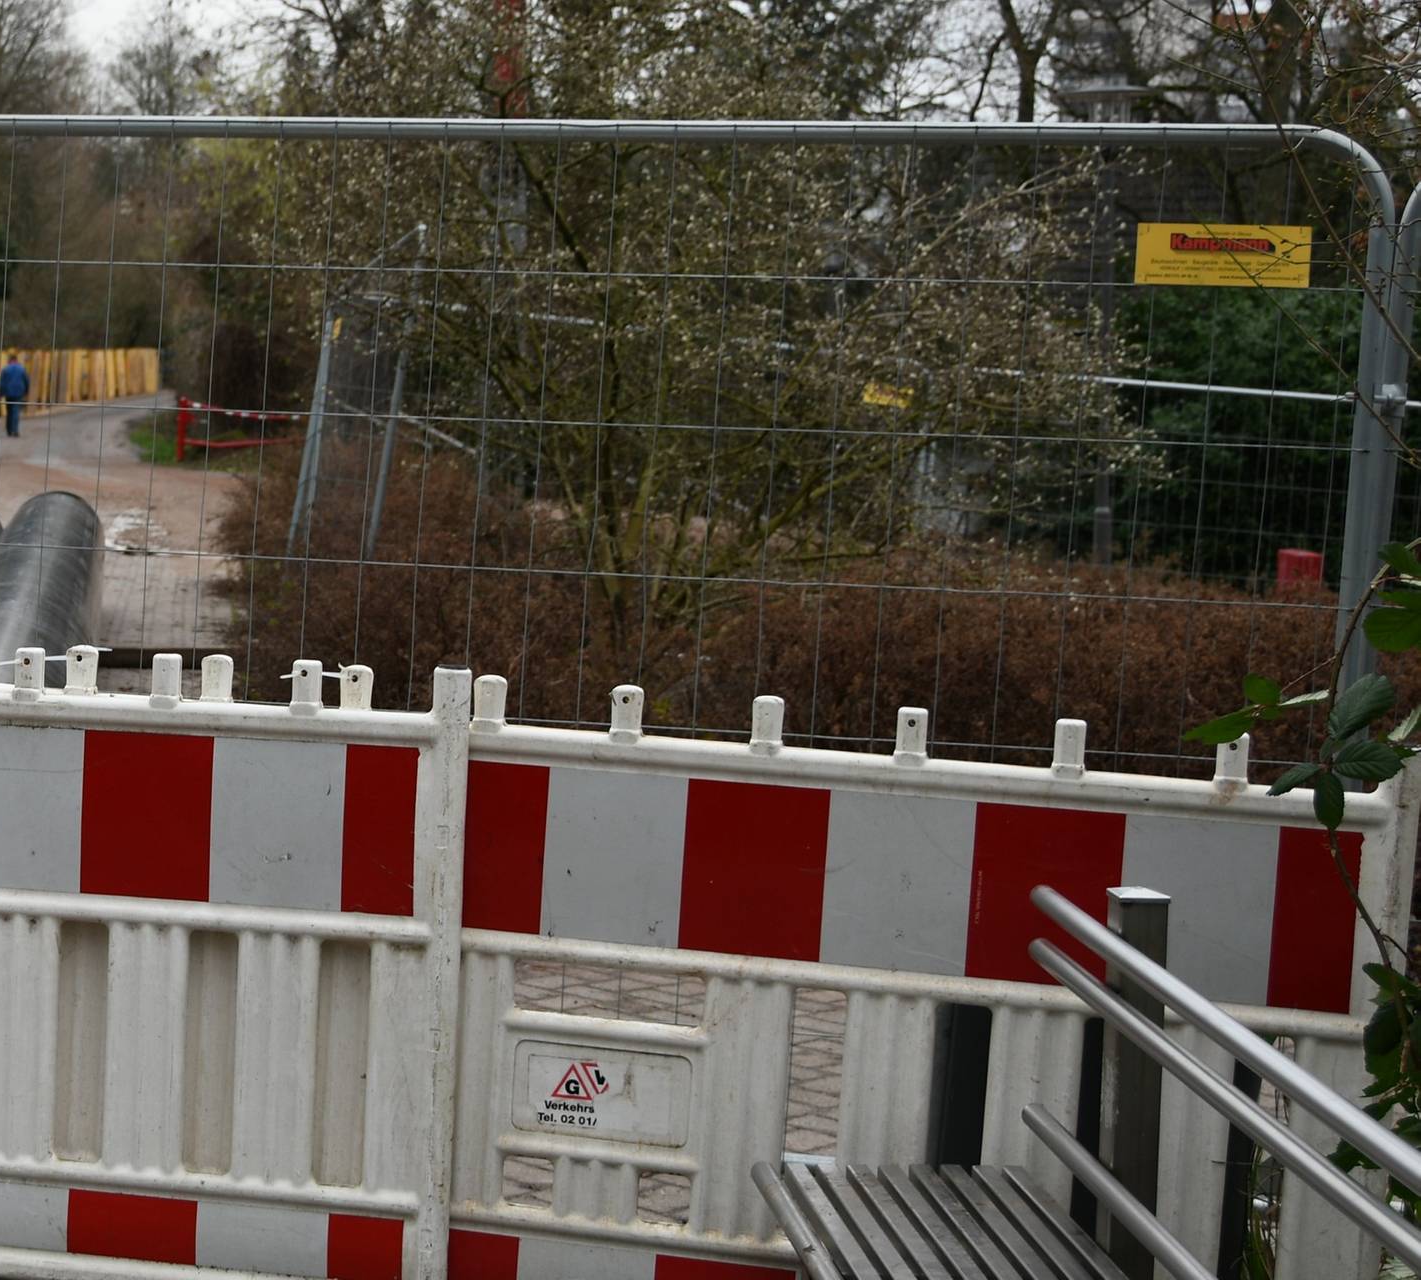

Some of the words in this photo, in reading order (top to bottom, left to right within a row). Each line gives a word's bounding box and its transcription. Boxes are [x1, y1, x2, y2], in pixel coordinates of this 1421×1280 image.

[1171, 233, 1270, 252] Kampmann
[544, 1100, 595, 1113] Verkehrs
[537, 1112, 557, 1123] Tel.
[560, 1115, 575, 1124] 02
[578, 1116, 598, 1126] 01/
